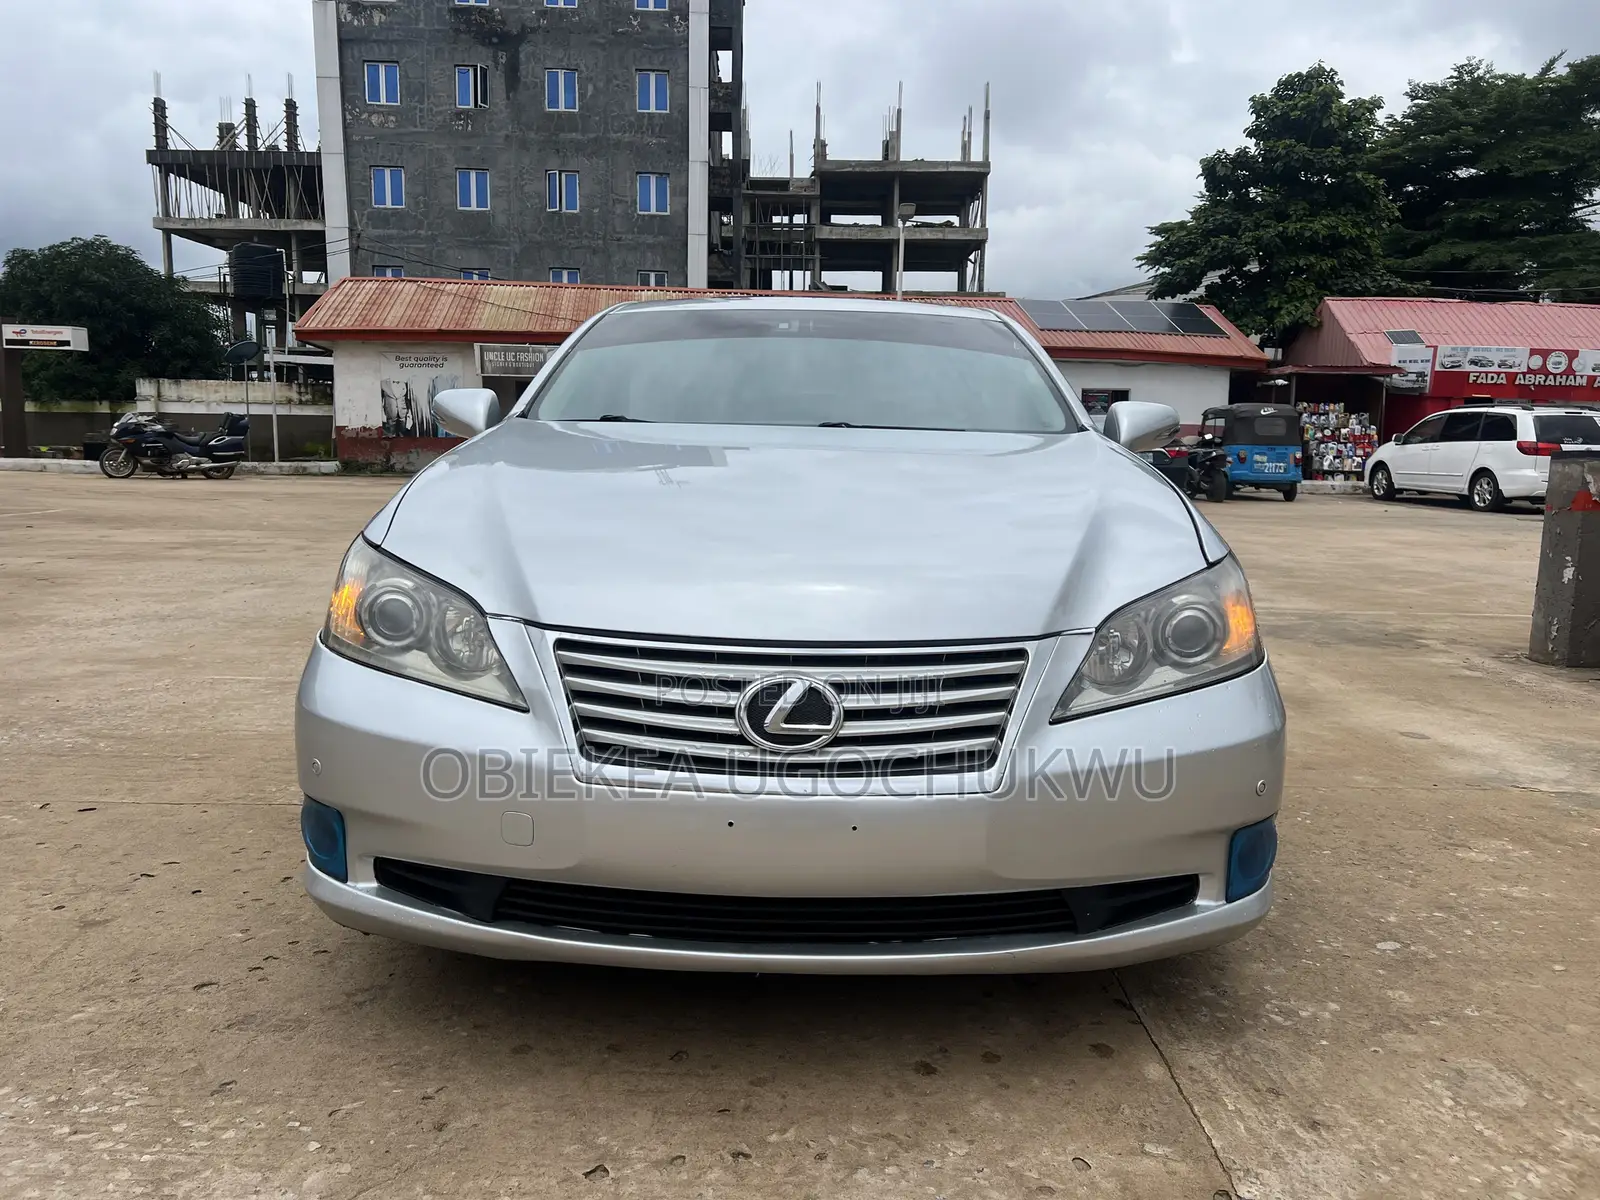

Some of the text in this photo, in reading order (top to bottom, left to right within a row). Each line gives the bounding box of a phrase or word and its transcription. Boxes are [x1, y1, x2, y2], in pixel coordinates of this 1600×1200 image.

[413, 355, 440, 363] quality
[484, 351, 544, 362] UNCLE UC FASHION
[1468, 372, 1507, 385] FADA
[1515, 373, 1588, 387] ABRAHAM
